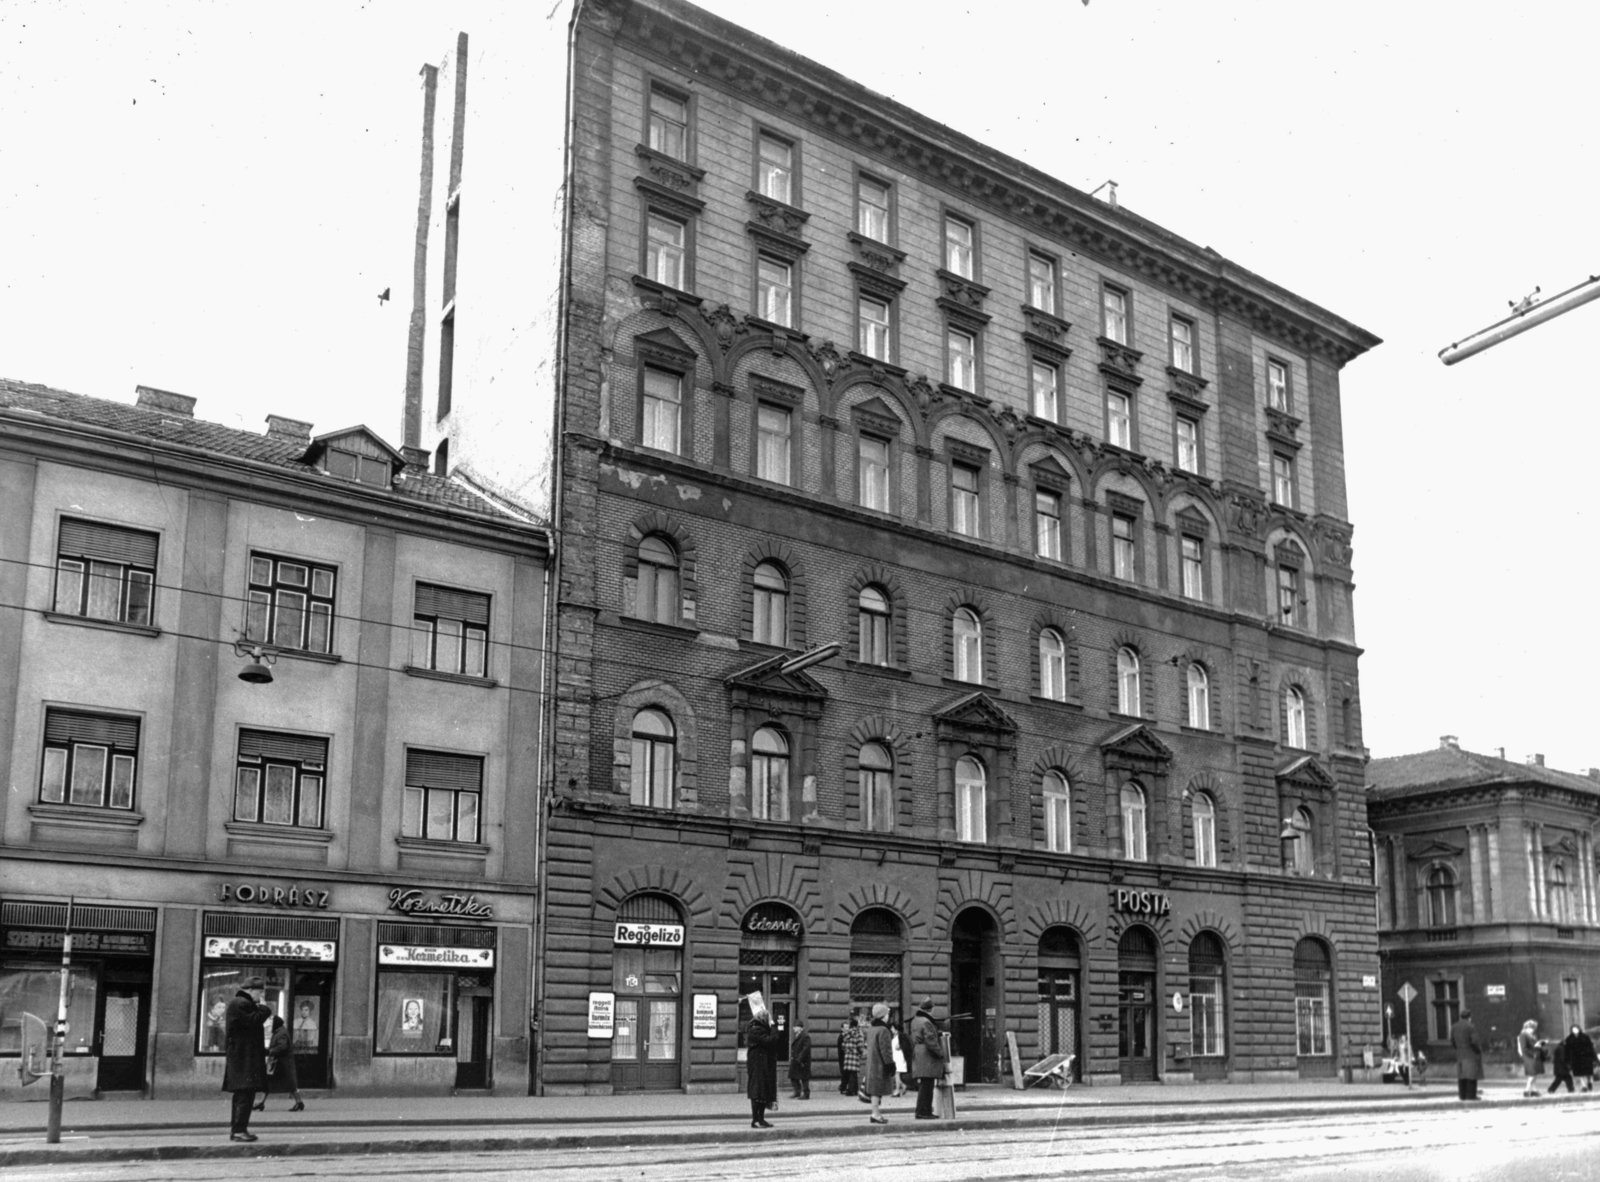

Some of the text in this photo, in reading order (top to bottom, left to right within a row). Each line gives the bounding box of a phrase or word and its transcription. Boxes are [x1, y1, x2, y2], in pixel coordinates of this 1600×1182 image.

[221, 883, 329, 908] FODRÁSZ
[389, 887, 494, 919] Kozmetika
[1117, 889, 1170, 914] POSTA
[7, 931, 99, 949] SZEMFELSEDÉS
[617, 926, 681, 944] Reggeliző
[403, 947, 471, 964] Kozmetika
